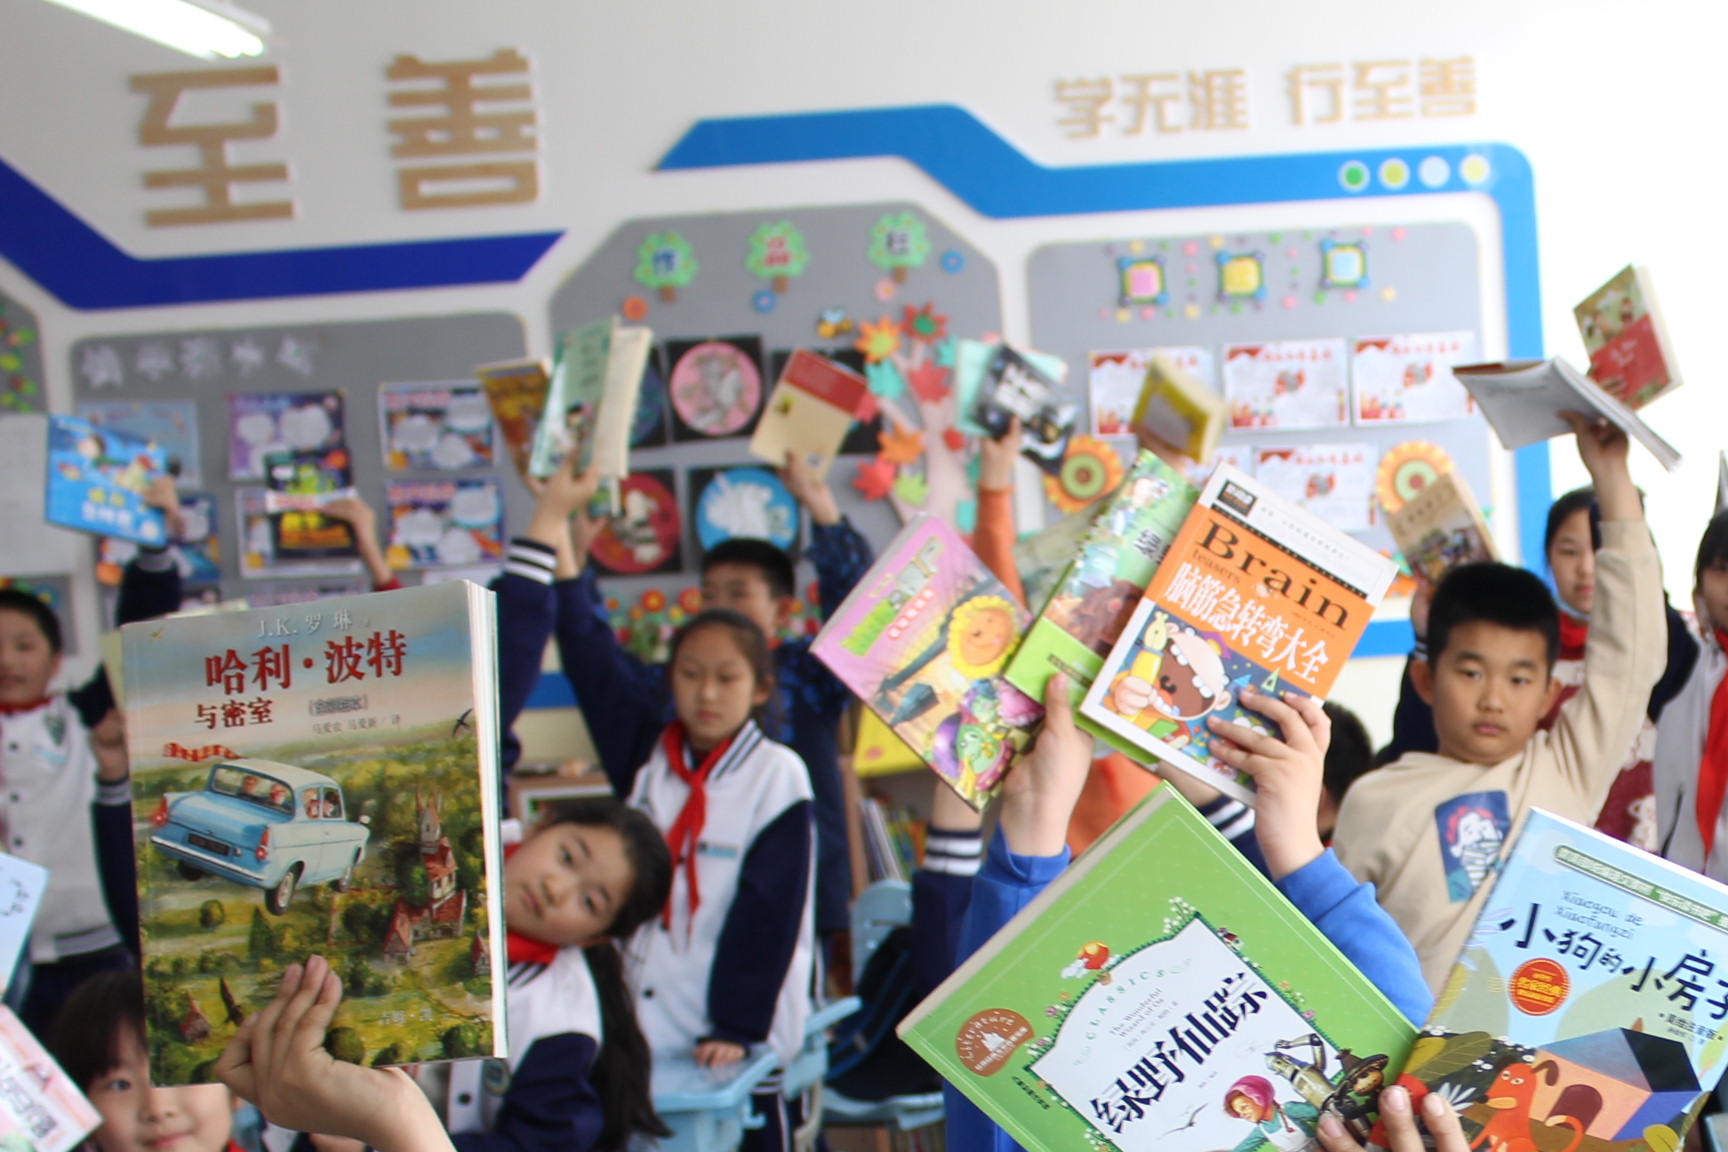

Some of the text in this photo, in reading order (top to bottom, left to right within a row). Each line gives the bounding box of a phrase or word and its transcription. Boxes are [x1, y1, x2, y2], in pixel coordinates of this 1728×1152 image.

[129, 48, 538, 228] 至善
[1054, 55, 1477, 141] 学无涯 行至善
[1192, 548, 1242, 584] teasers
[1196, 518, 1352, 630] Brain
[205, 629, 408, 696] 哈利·波特
[1162, 561, 1328, 684] 脑筋急转弯大全
[194, 696, 274, 731] 与密室
[1085, 968, 1165, 1041] CLASSICS
[1089, 972, 1268, 1134] 绿野仙踪
